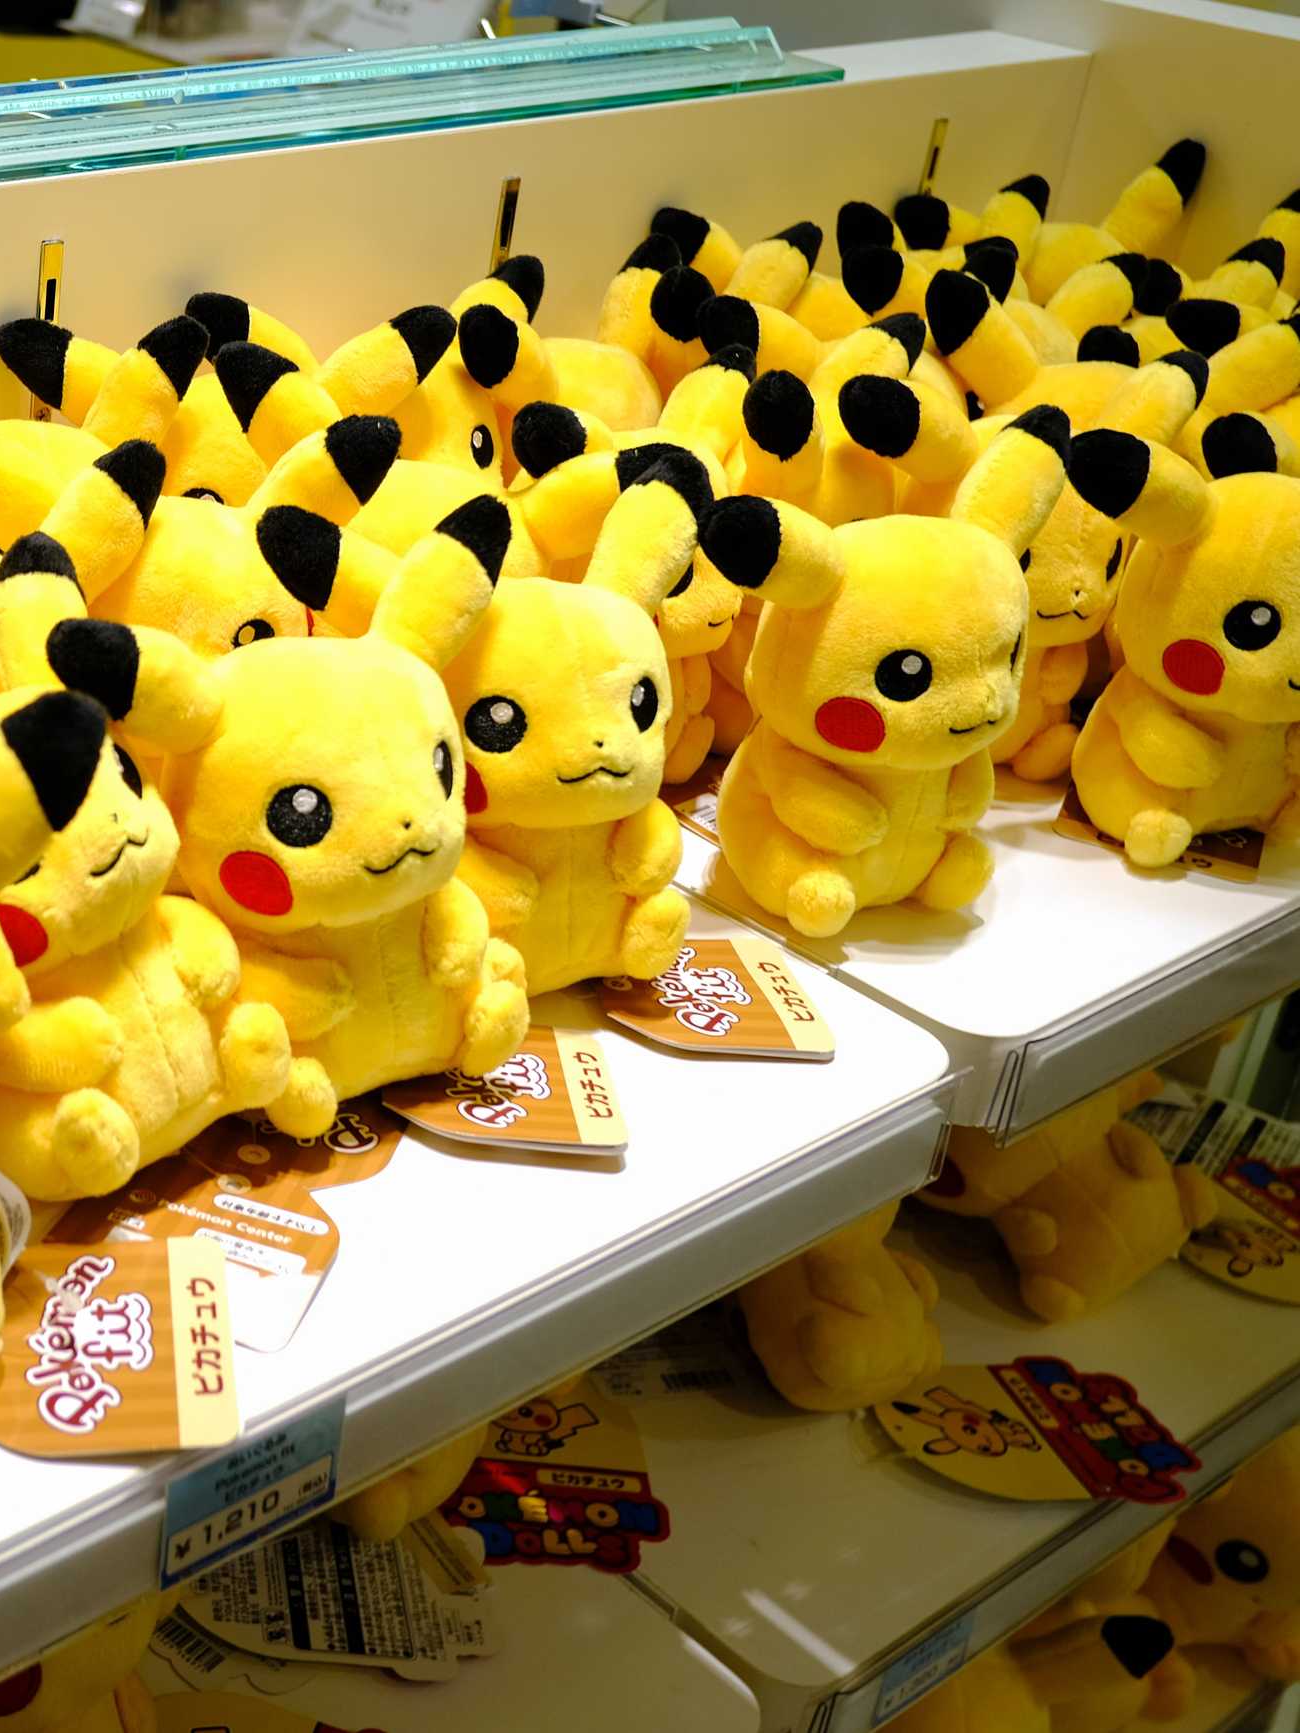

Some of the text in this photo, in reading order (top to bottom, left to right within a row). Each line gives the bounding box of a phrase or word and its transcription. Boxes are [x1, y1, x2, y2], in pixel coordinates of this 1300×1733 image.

[758, 962, 815, 1022] ピカチュウ
[573, 1052, 614, 1119] ピカチュウ
[79, 1297, 146, 1368] fit
[186, 1276, 225, 1397] ピカチュウ
[551, 1469, 626, 1490] ピカチュウ
